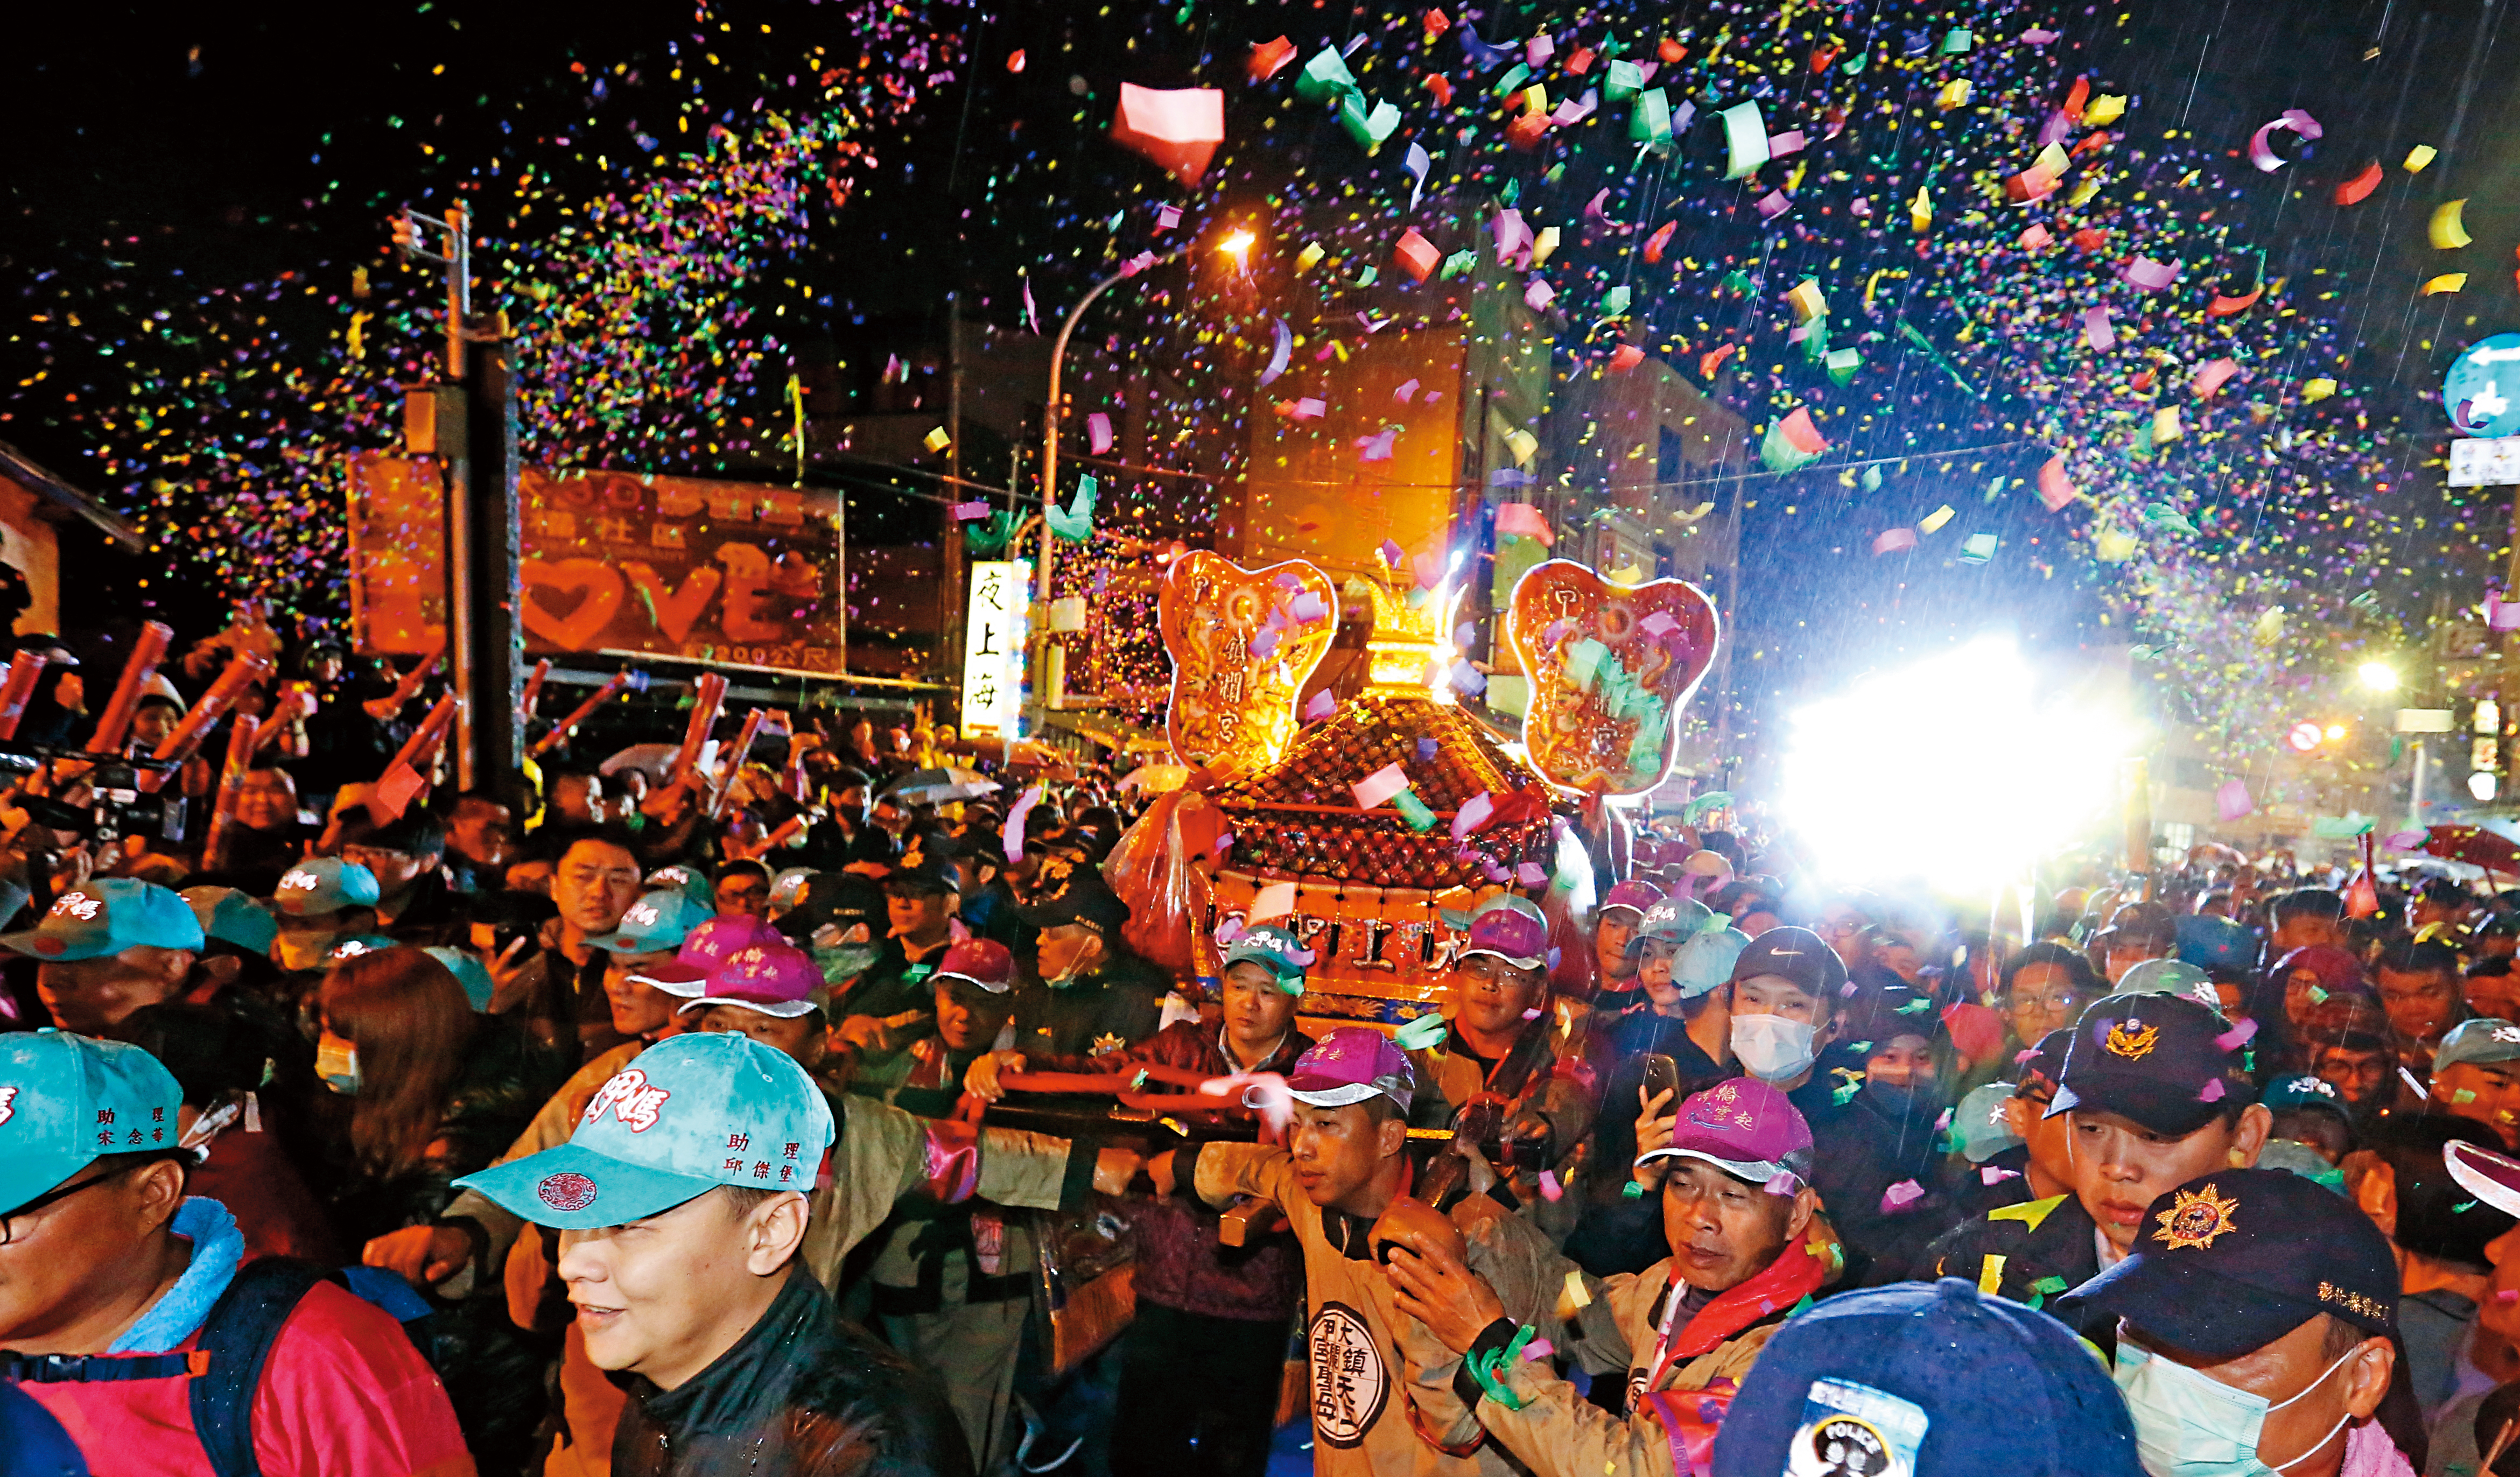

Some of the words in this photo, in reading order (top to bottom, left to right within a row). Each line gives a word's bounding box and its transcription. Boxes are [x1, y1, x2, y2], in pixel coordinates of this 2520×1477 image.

[969, 571, 1003, 709] 夜上海
[1642, 905, 1677, 928] 大甲媽
[1240, 930, 1283, 953] 大甲媽
[726, 1133, 800, 1159] 助理
[1825, 1422, 1882, 1454] POLICE
